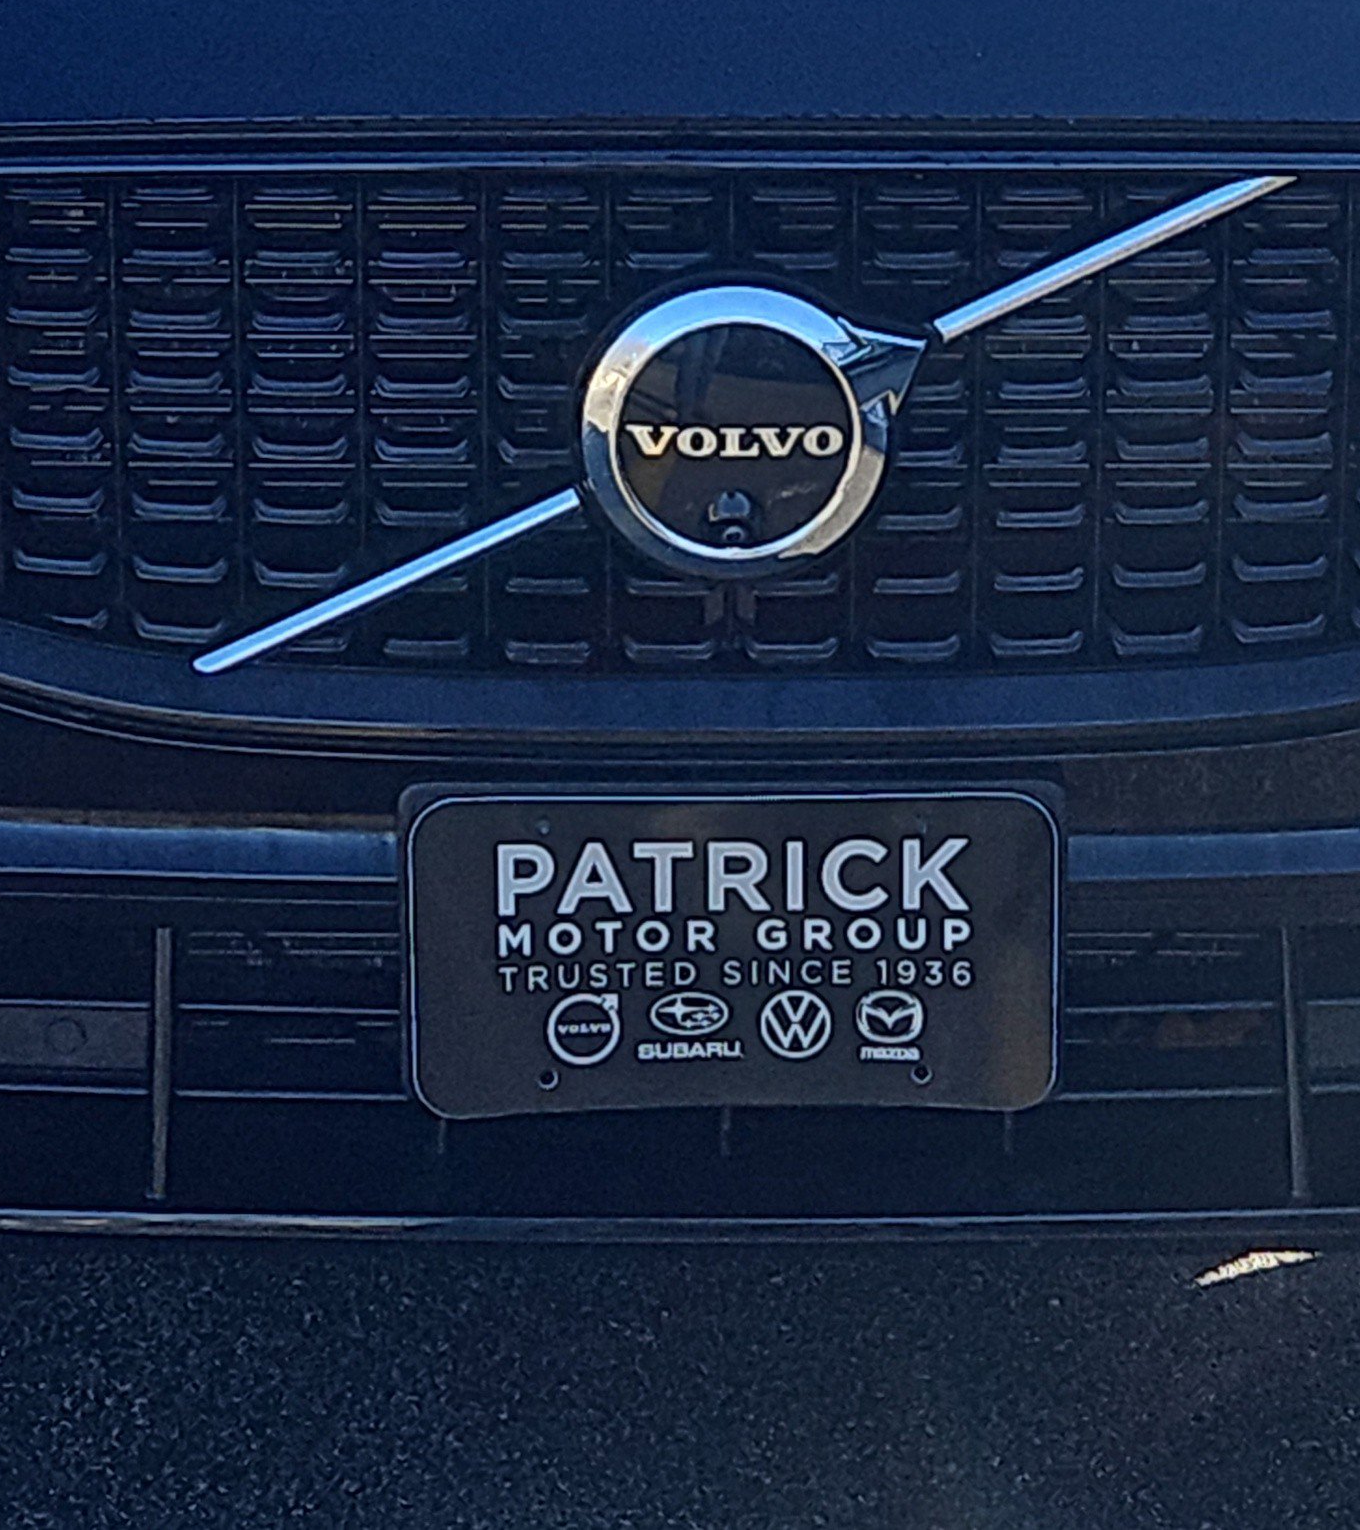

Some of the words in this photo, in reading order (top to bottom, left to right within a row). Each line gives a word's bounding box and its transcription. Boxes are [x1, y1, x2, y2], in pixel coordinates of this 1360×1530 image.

[625, 424, 844, 458] VOLVO
[497, 837, 970, 917] PATRICK
[498, 920, 716, 958] MOTOR
[756, 917, 972, 952] GROUP
[499, 961, 698, 993] TRUSTED
[723, 959, 852, 986] SINCE
[876, 959, 972, 986] 1936
[557, 1023, 612, 1035] VOLVO
[638, 1041, 744, 1060] SUBARU
